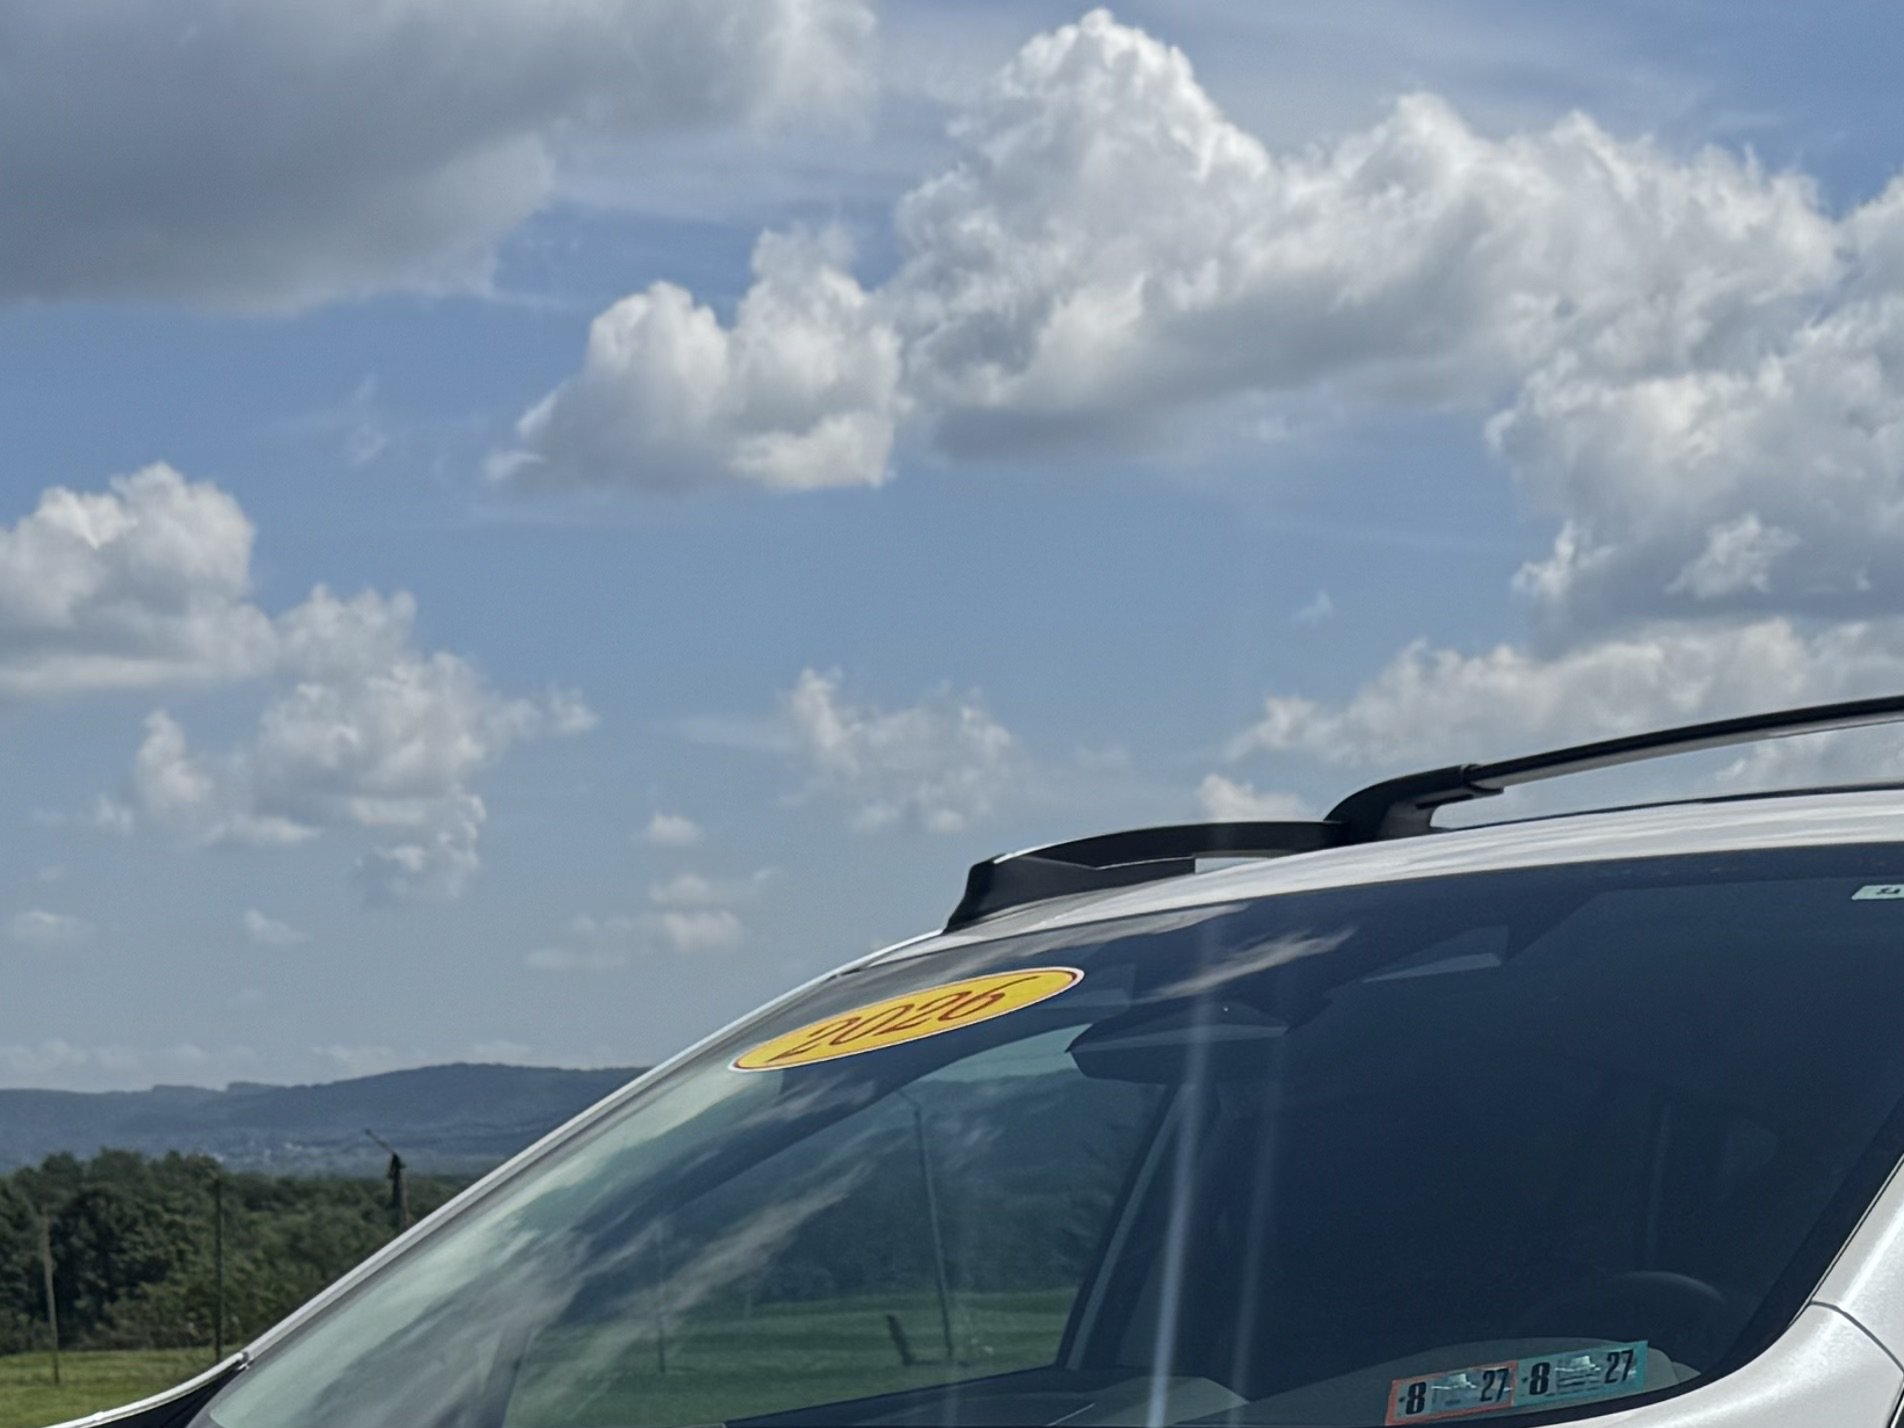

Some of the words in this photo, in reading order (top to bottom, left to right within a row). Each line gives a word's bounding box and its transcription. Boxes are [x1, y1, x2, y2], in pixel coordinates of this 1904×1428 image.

[766, 976, 1039, 1062] 2026
[1405, 1381, 1426, 1415] 8
[1480, 1368, 1509, 1402] 27
[1529, 1362, 1551, 1395] 8
[1604, 1349, 1634, 1383] 27
